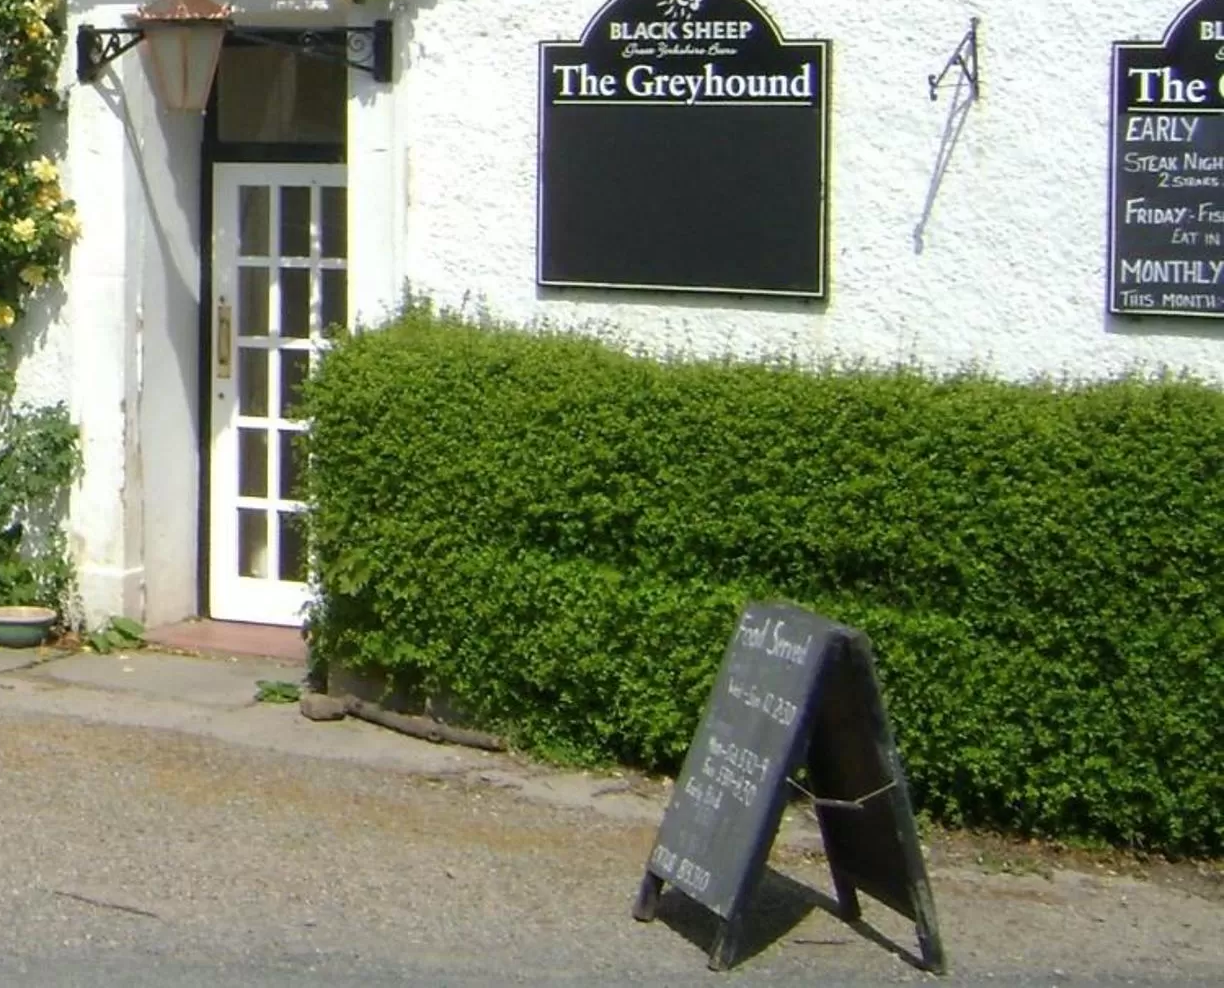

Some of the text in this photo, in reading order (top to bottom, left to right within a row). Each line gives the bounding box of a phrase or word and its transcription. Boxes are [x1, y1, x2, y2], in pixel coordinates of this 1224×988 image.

[610, 20, 753, 40] BLACK SHEEP
[553, 63, 812, 105] The Greyhound
[1128, 66, 1207, 103] The
[1126, 115, 1201, 142] EARLY
[1121, 258, 1224, 284] MONTHLY
